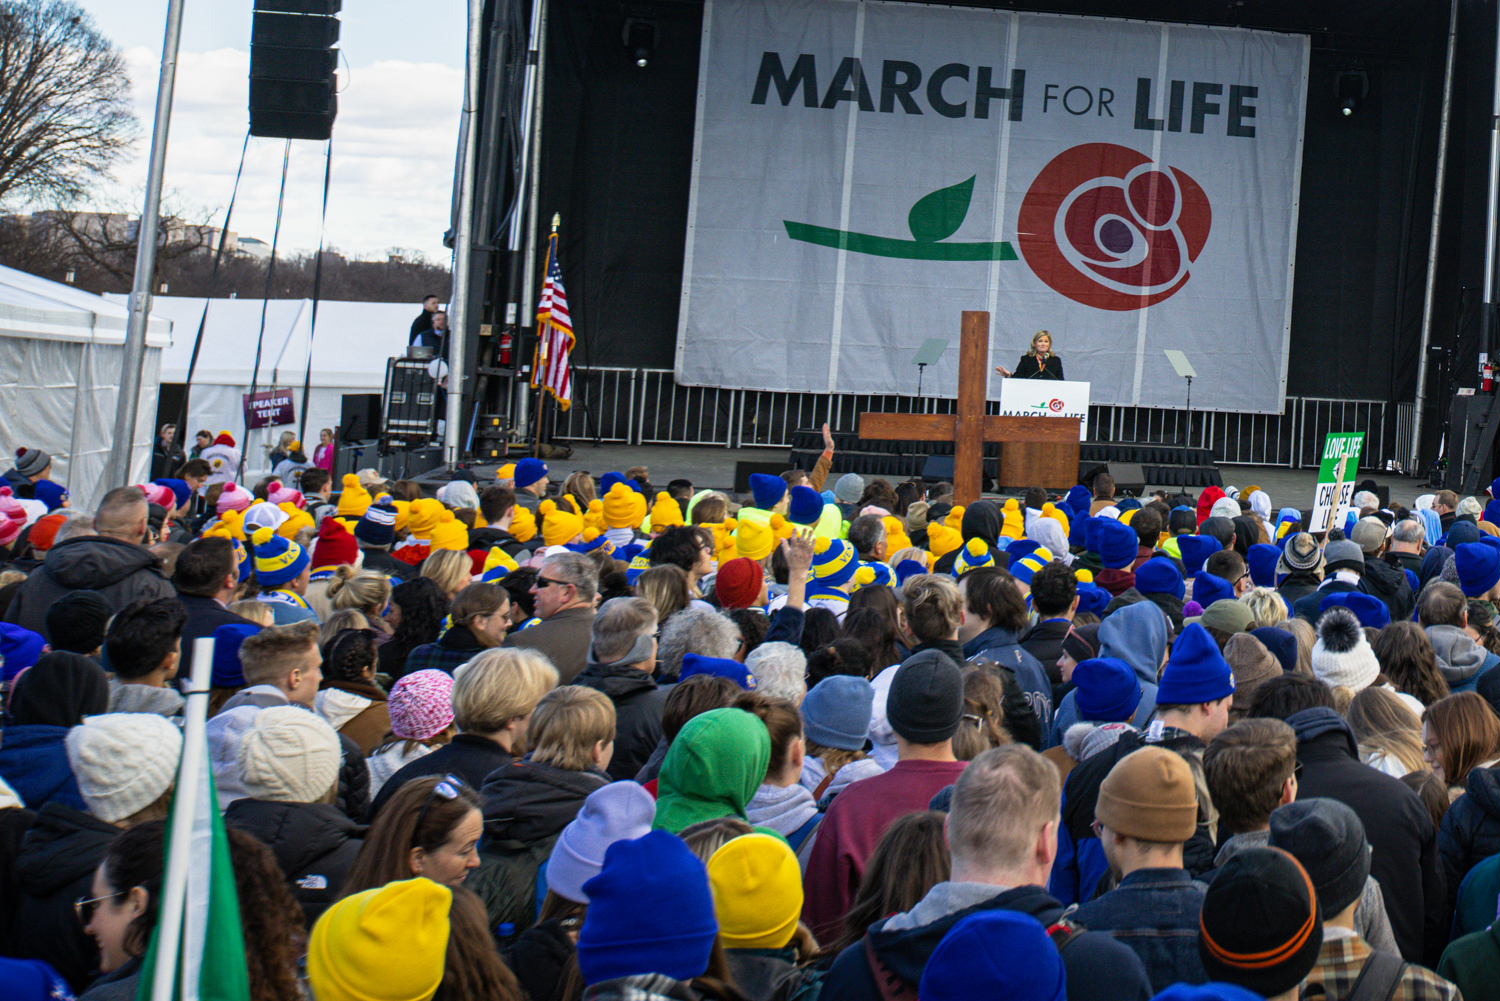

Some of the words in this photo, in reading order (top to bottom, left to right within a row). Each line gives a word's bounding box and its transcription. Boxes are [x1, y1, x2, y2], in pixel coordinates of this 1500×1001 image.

[750, 51, 1026, 122] MARCH
[1043, 83, 1115, 118] FOR
[1133, 77, 1260, 138] LIFE
